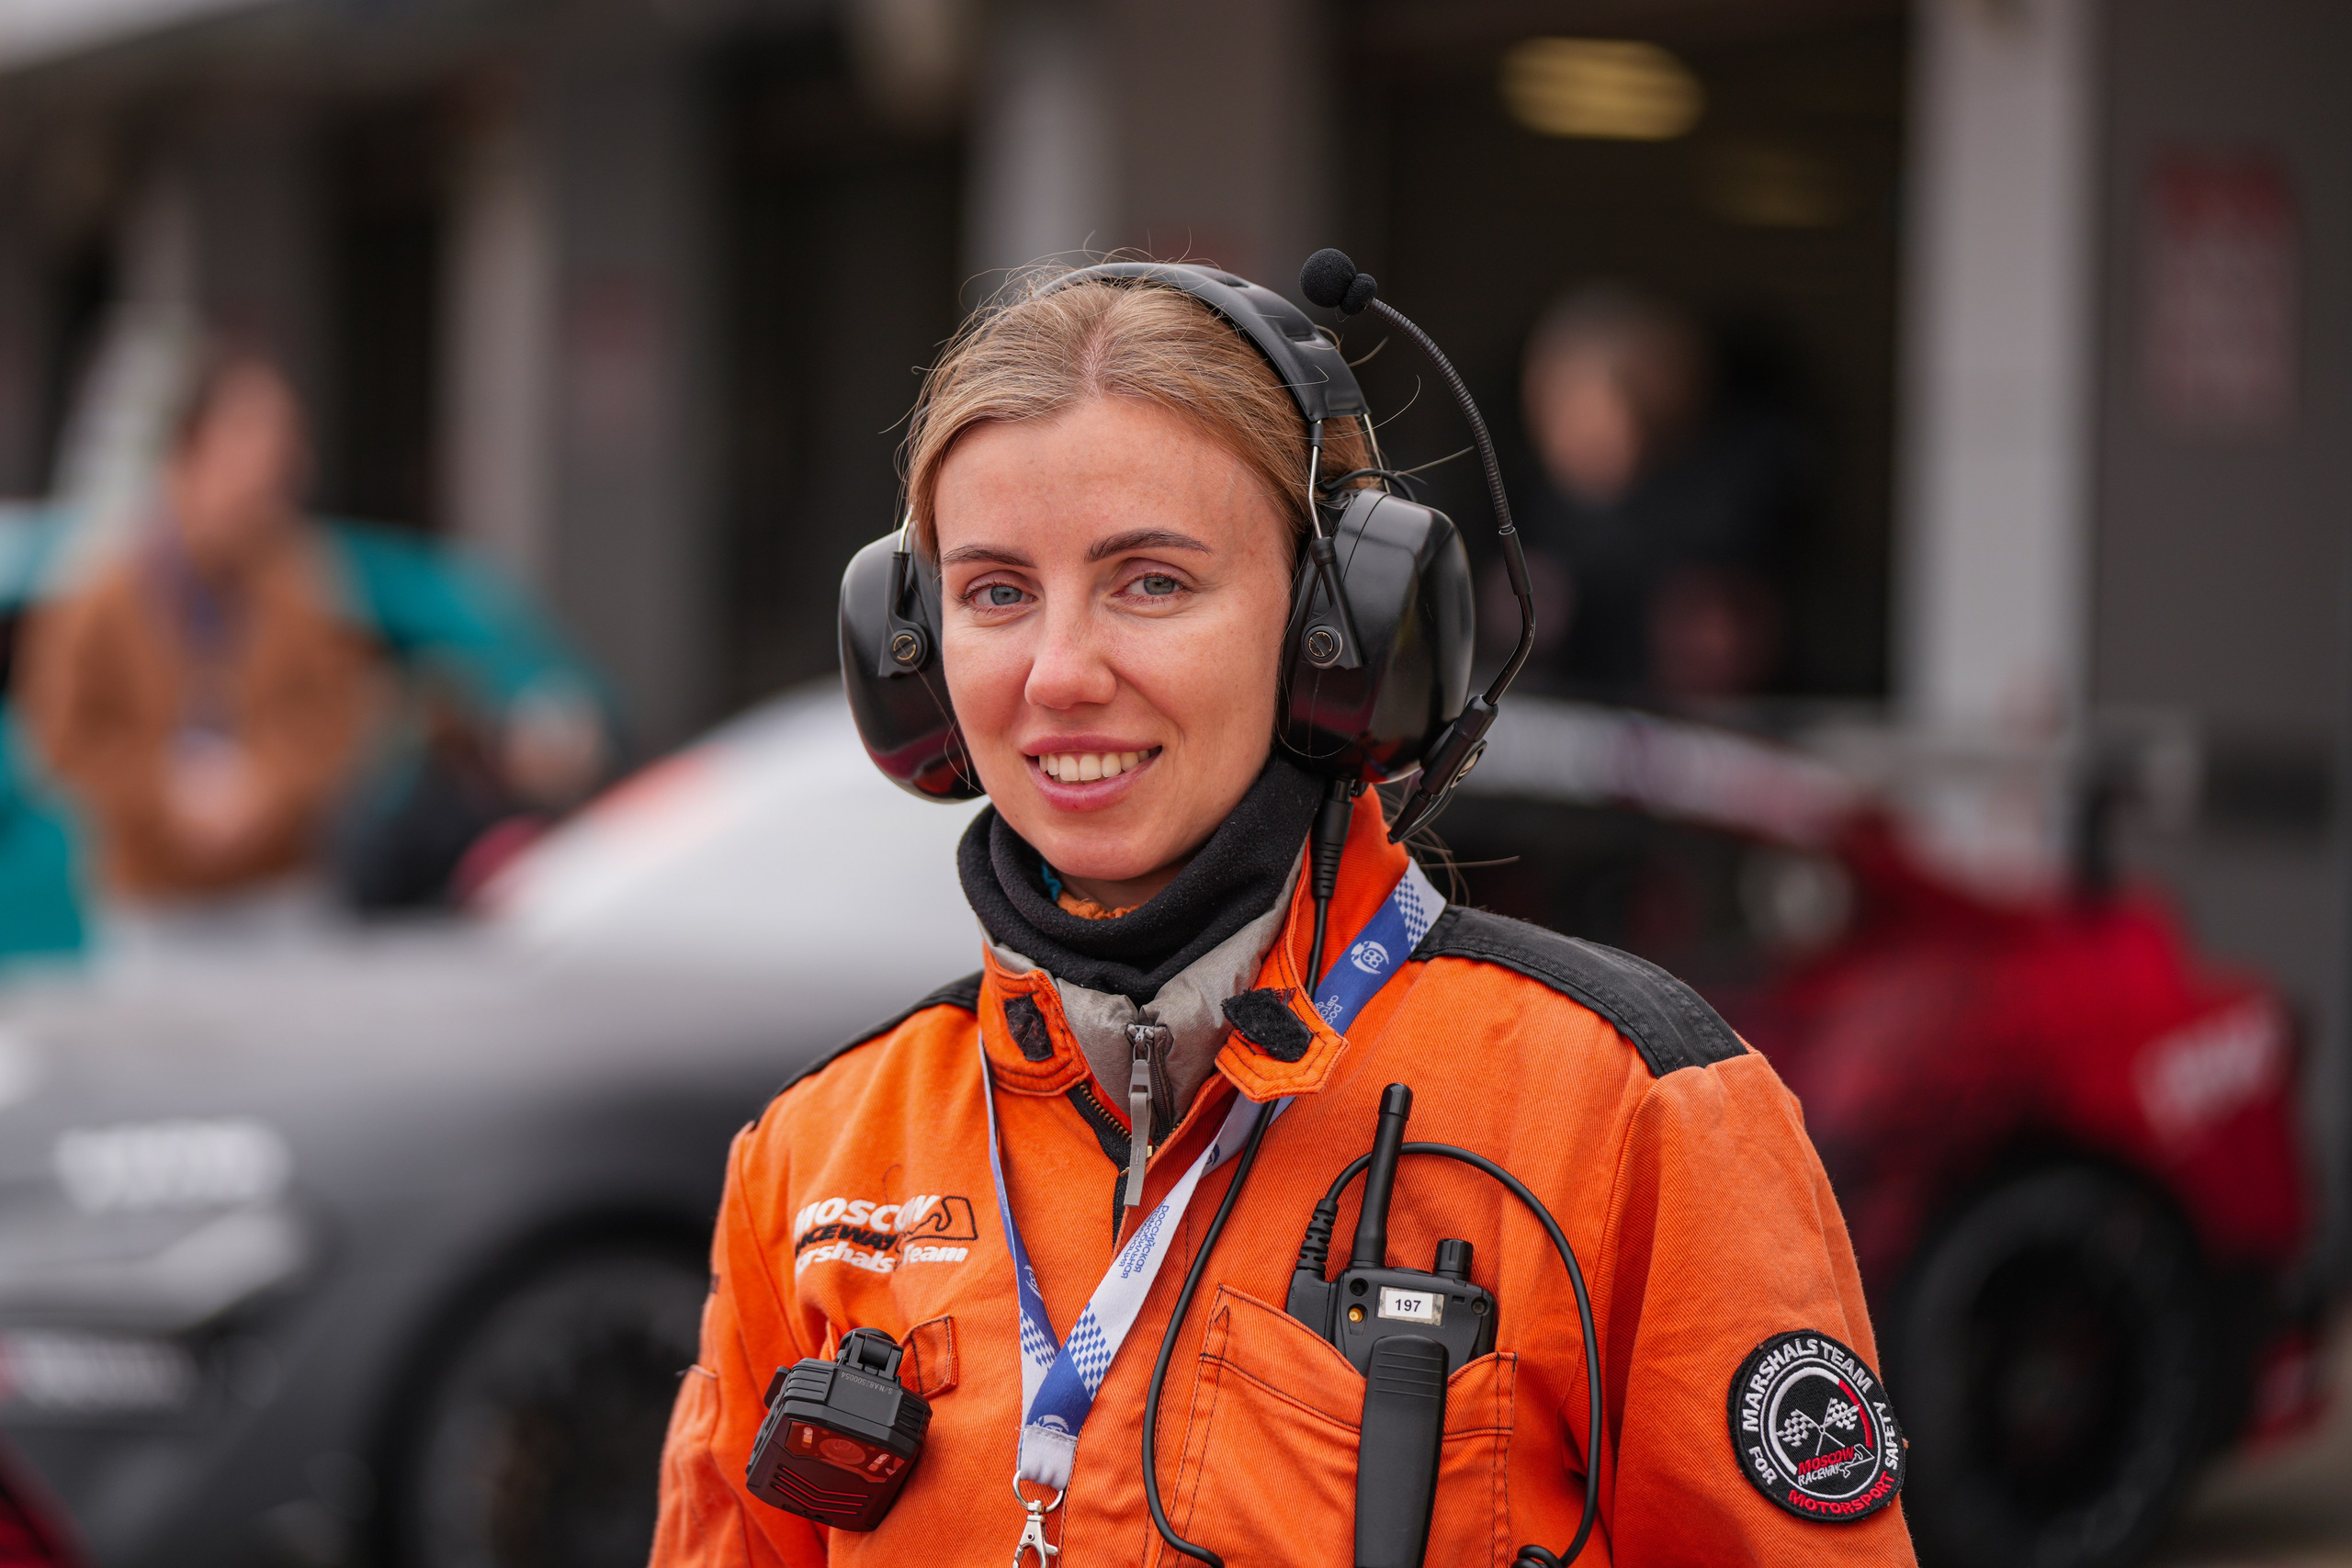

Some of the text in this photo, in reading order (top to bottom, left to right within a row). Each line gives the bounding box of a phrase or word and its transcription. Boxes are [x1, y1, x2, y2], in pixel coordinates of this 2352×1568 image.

[1321, 995, 1339, 1018] авто
[1133, 1205, 1170, 1273] российская
[795, 1241, 895, 1281] arshals
[1395, 1299, 1421, 1313] 197
[1742, 1338, 1873, 1432] MARSHALS TEAM
[1748, 1401, 1899, 1515] FOR MOTORSPORT SAFETY
[1797, 1462, 1840, 1486] RACEWAY
[1798, 1446, 1855, 1475] MOSCOW
